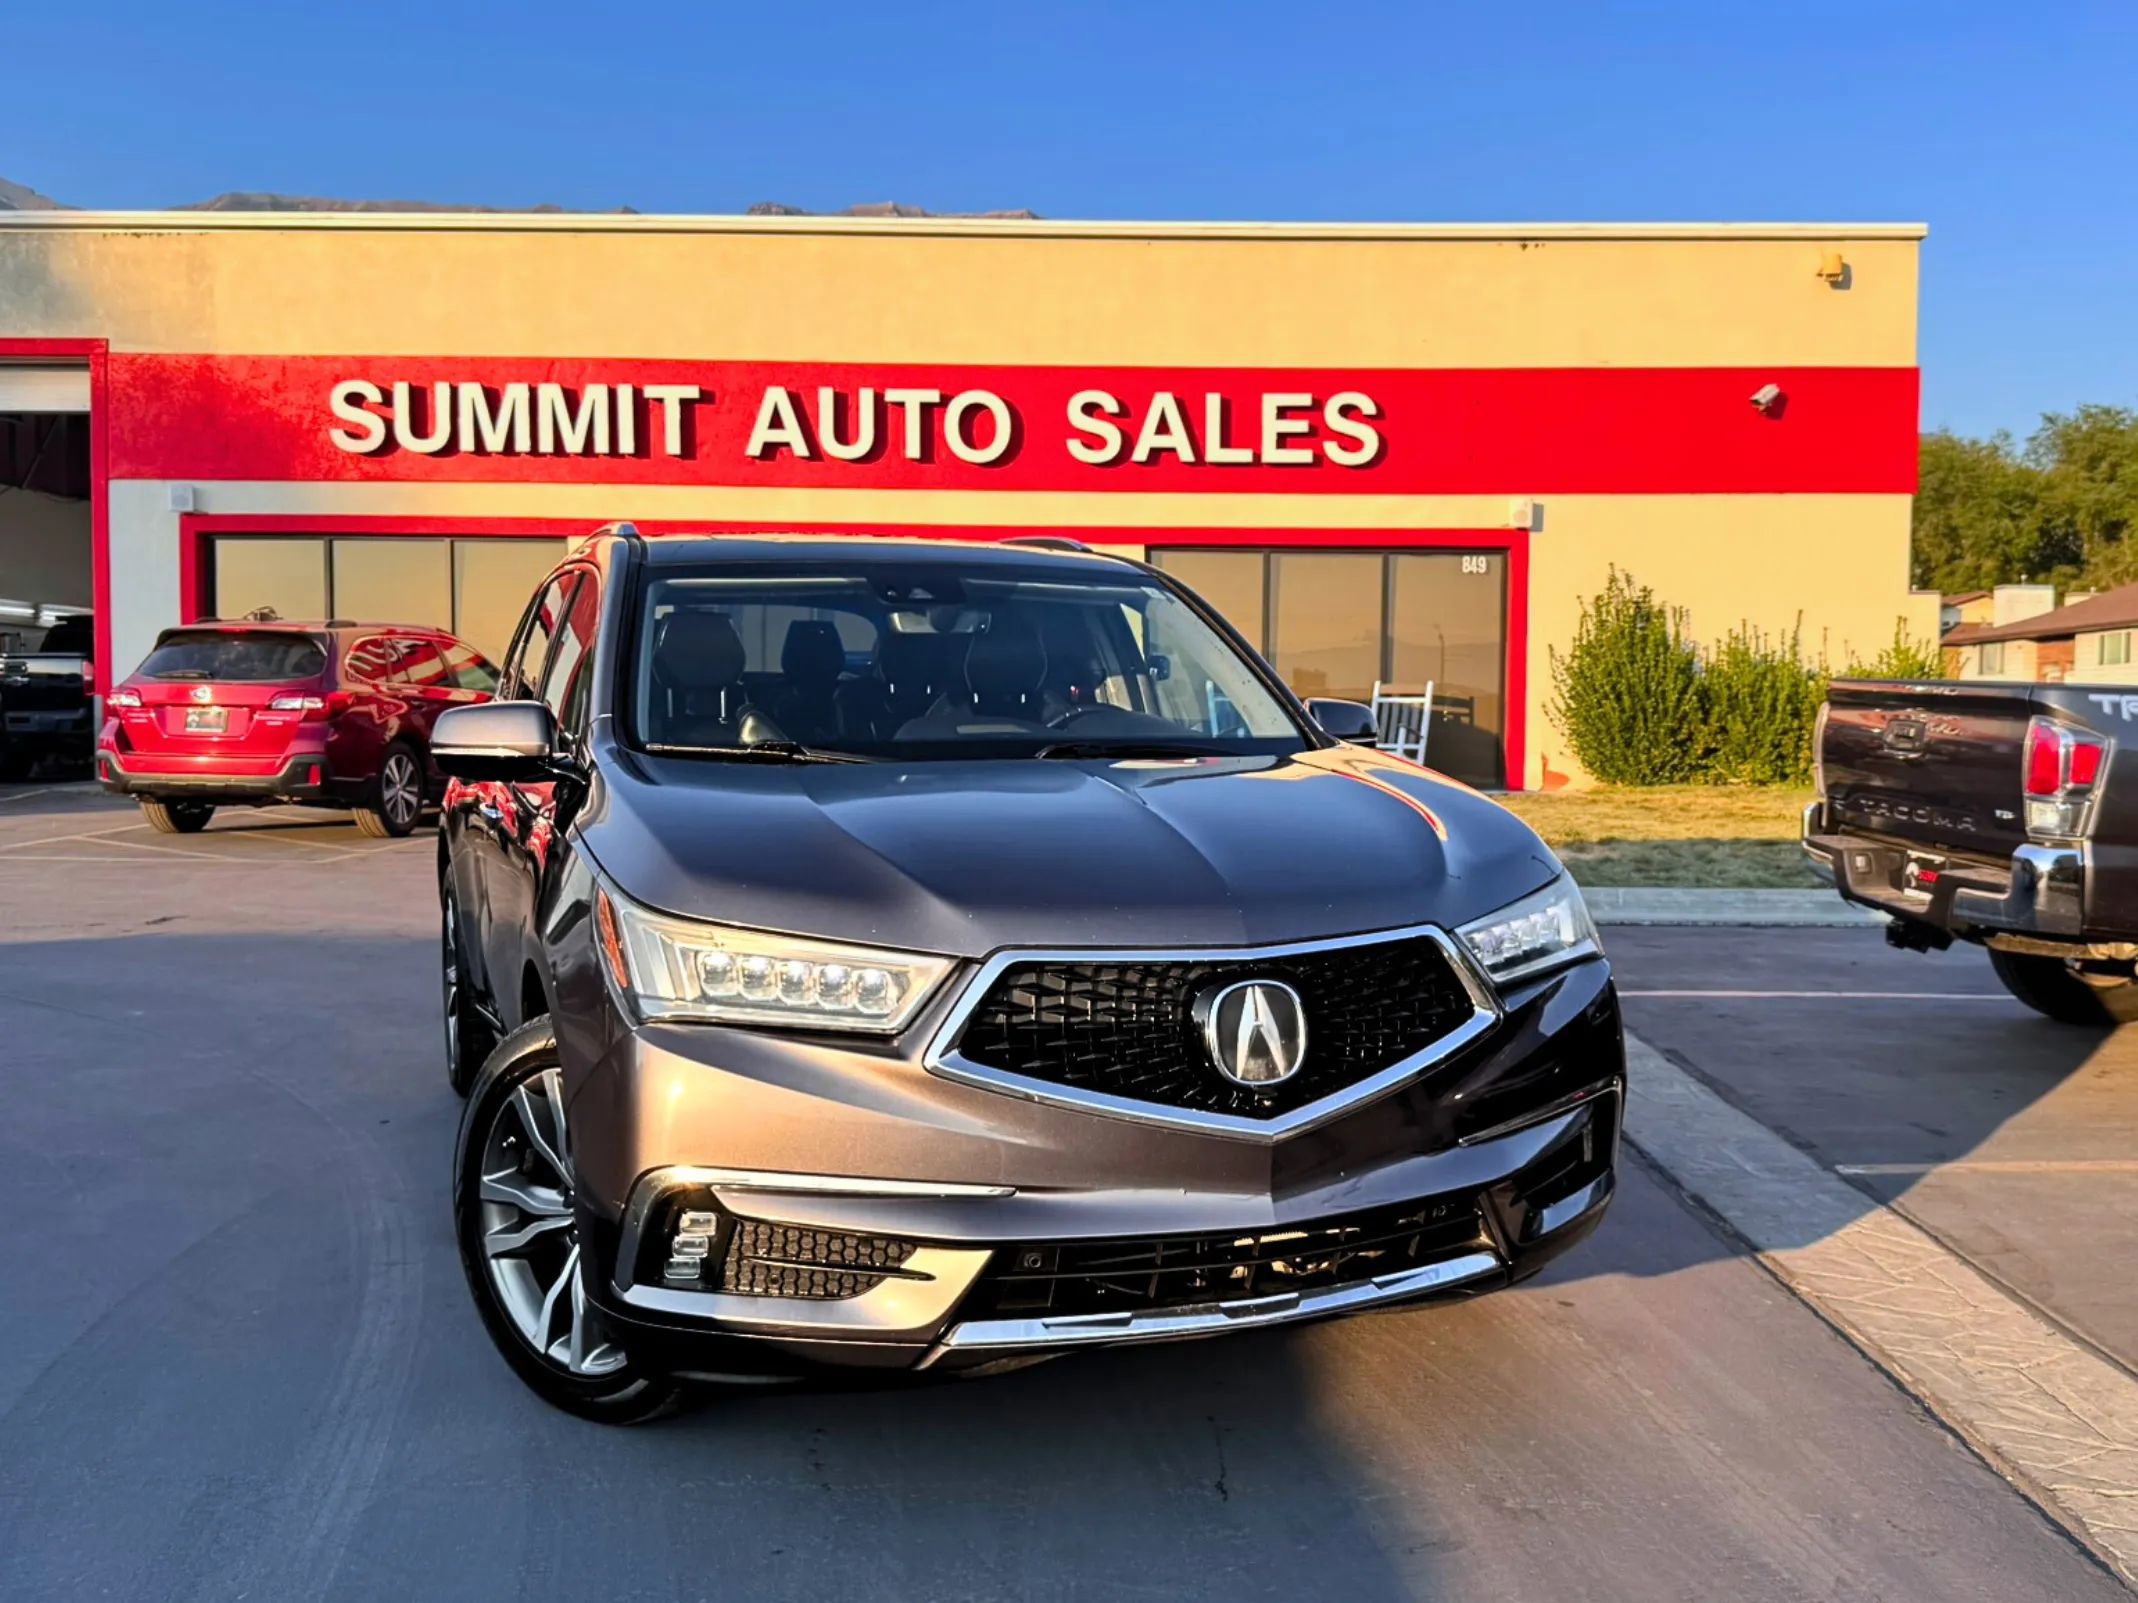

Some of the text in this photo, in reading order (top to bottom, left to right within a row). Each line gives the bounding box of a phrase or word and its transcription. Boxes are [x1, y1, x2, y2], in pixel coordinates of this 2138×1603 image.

[330, 380, 1381, 465] SUMMIT AUTO SALES
[1461, 555, 1487, 574] 849
